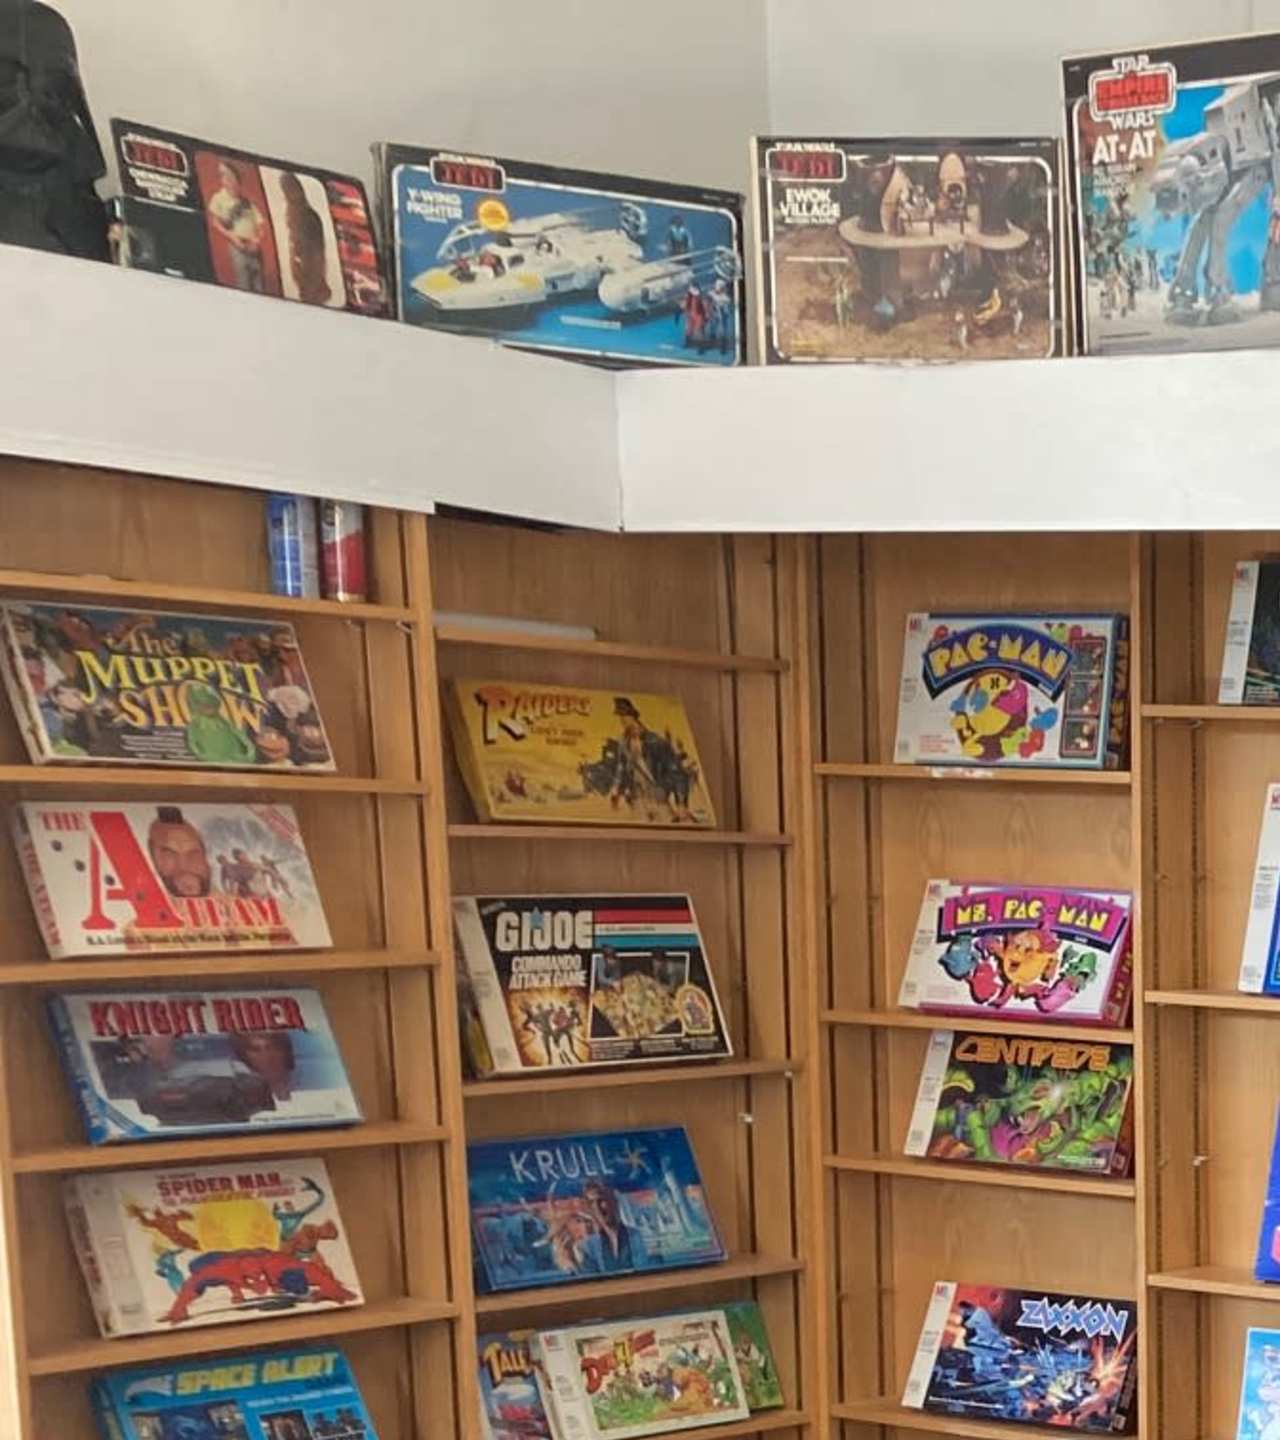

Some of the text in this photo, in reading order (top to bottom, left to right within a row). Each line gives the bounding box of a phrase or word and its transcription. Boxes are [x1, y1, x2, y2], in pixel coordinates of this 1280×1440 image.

[76, 650, 266, 705] MUPPET
[81, 811, 186, 931] A
[89, 996, 308, 1036] KNIGHT RIDER
[956, 1036, 1111, 1071] CENTIPEDE
[509, 1144, 616, 1183] KRULL
[157, 1177, 233, 1197] SPIDER
[1016, 1296, 1129, 1344] ZAXXON
